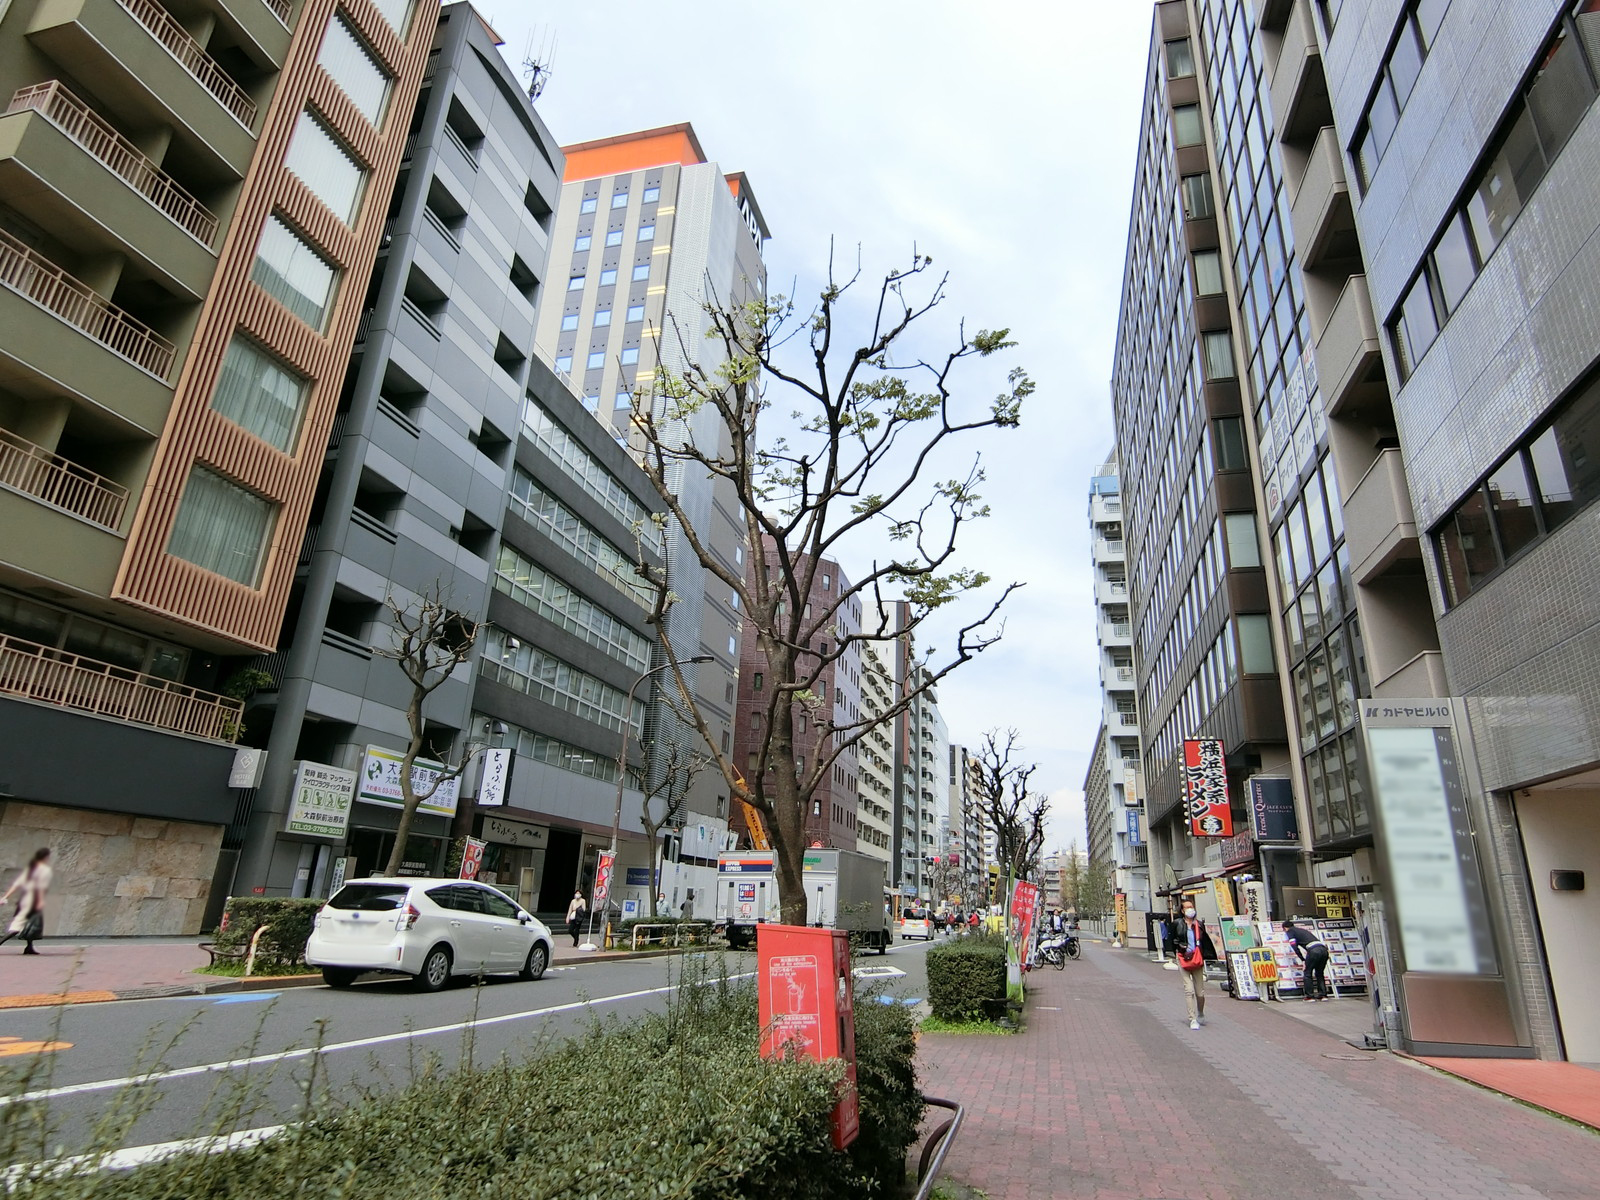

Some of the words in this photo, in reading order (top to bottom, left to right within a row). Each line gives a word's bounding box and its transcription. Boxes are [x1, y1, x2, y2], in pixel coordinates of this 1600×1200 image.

[1383, 707, 1449, 717] カドヤビル10
[330, 774, 353, 785] マッサージ
[387, 762, 455, 788] 大駅前整院
[1199, 740, 1226, 804] 横浜家系
[1187, 766, 1210, 818] ラーメン
[1255, 783, 1266, 812] Quarter
[1259, 812, 1267, 836] French
[1287, 831, 1296, 839] 2F
[1317, 894, 1348, 905] 日焼け
